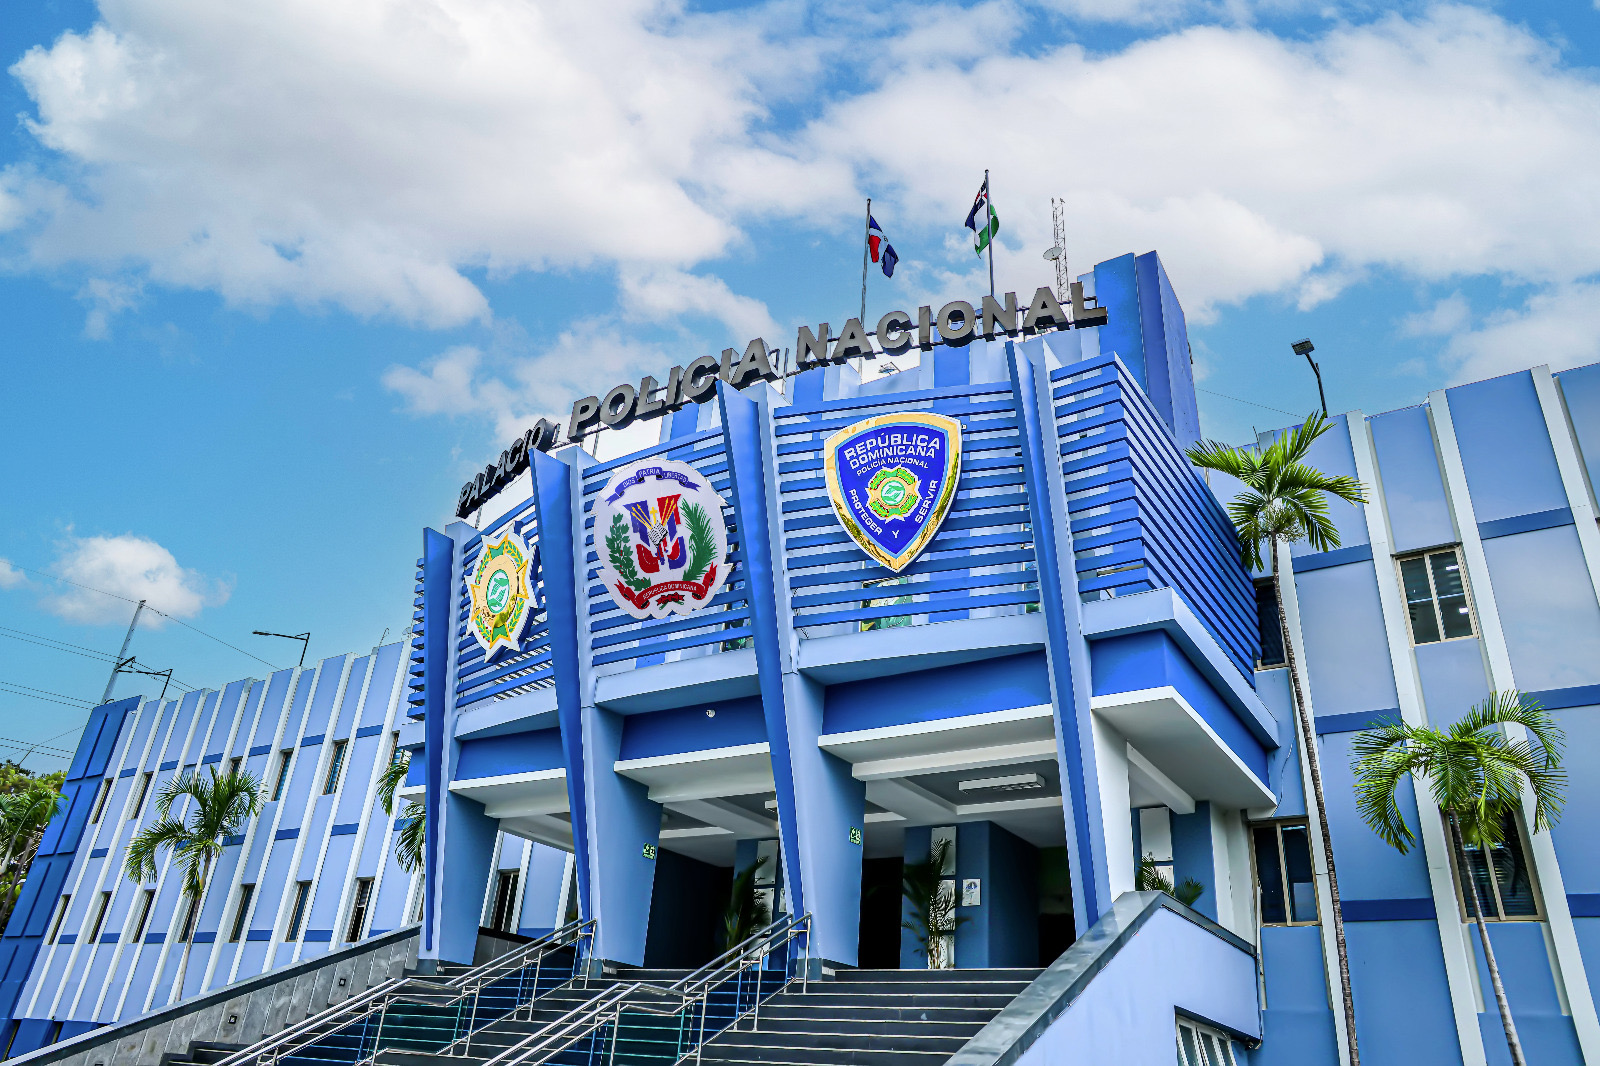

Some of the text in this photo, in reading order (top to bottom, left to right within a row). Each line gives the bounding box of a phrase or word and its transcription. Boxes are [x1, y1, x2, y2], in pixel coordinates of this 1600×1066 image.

[456, 281, 1108, 518] PALACIO POLICIA NACIONAL
[844, 433, 940, 460] REPÚBLICA
[850, 445, 935, 469] DOMINICANA
[638, 468, 660, 478] PATRIA
[887, 457, 929, 469] NACIONAL
[849, 480, 938, 538] PROTEGER Y SERVIR
